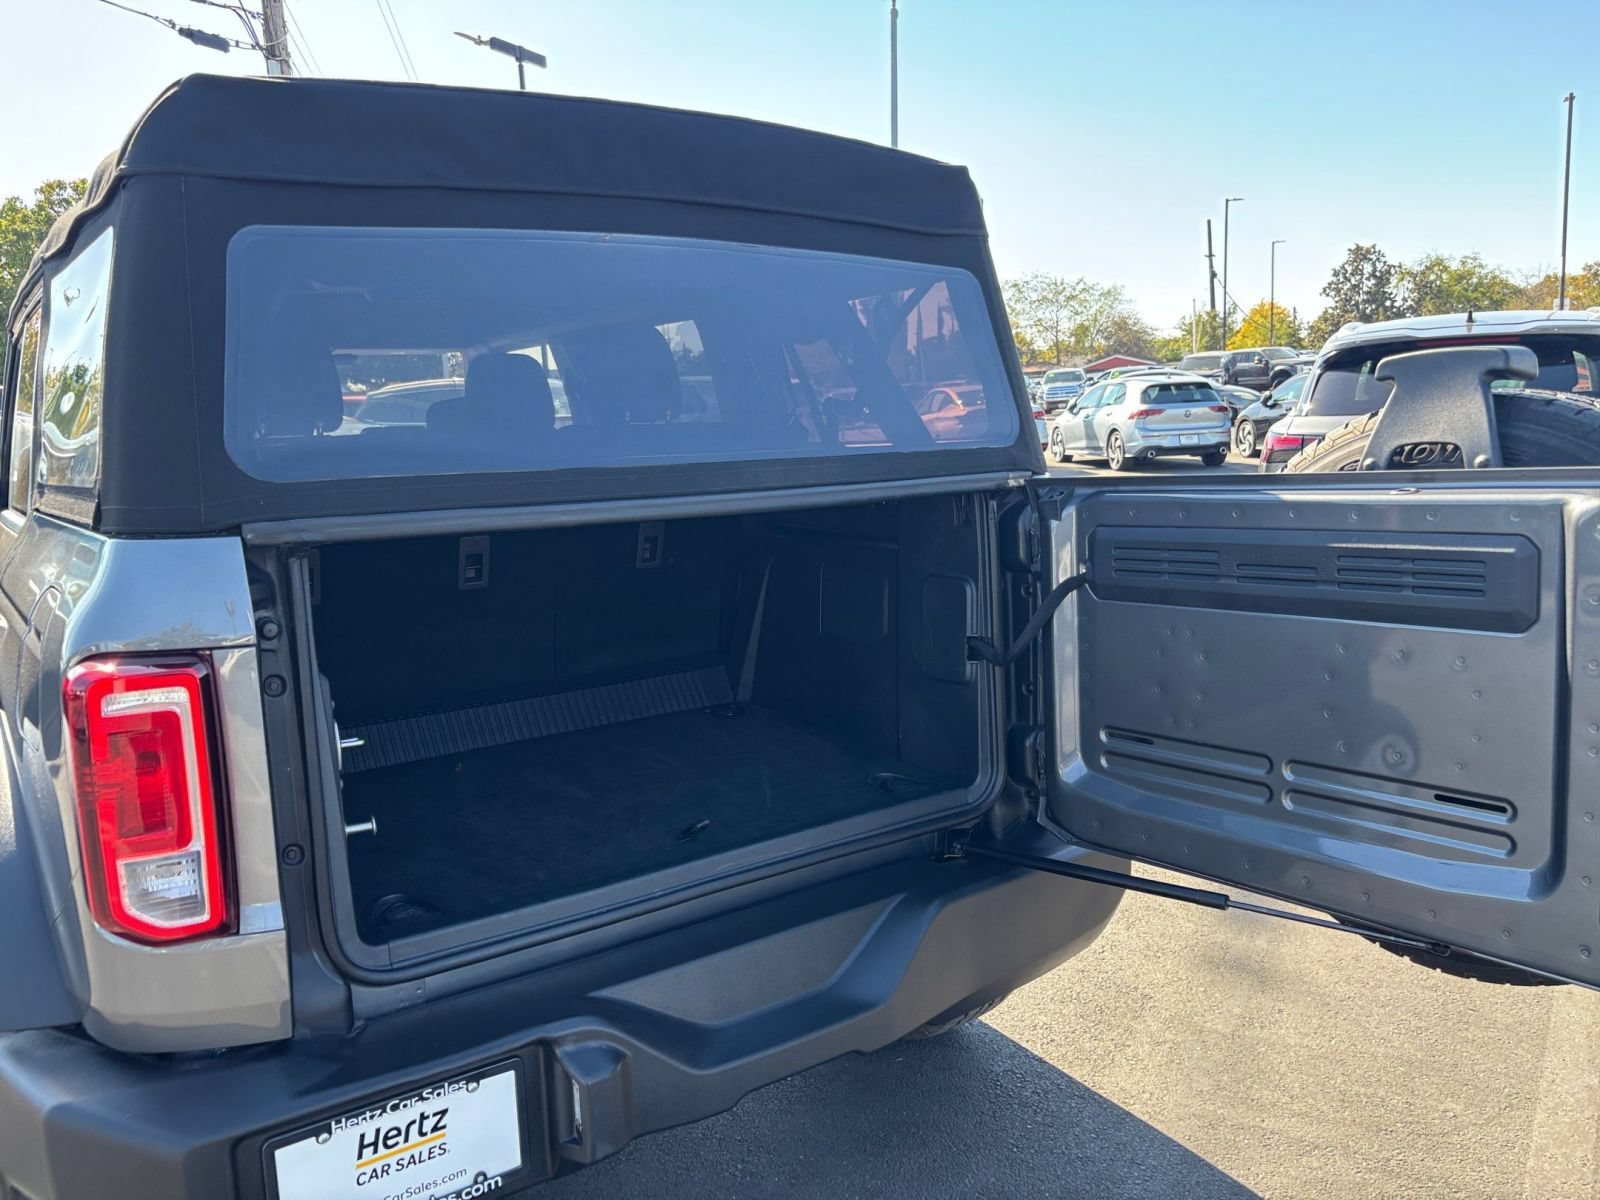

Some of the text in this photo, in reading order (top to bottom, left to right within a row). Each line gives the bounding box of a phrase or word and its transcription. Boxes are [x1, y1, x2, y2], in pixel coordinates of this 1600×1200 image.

[331, 1080, 467, 1134] Hertz Car Sales
[355, 1107, 449, 1161] Hertz
[356, 1142, 447, 1187] CAR SALES
